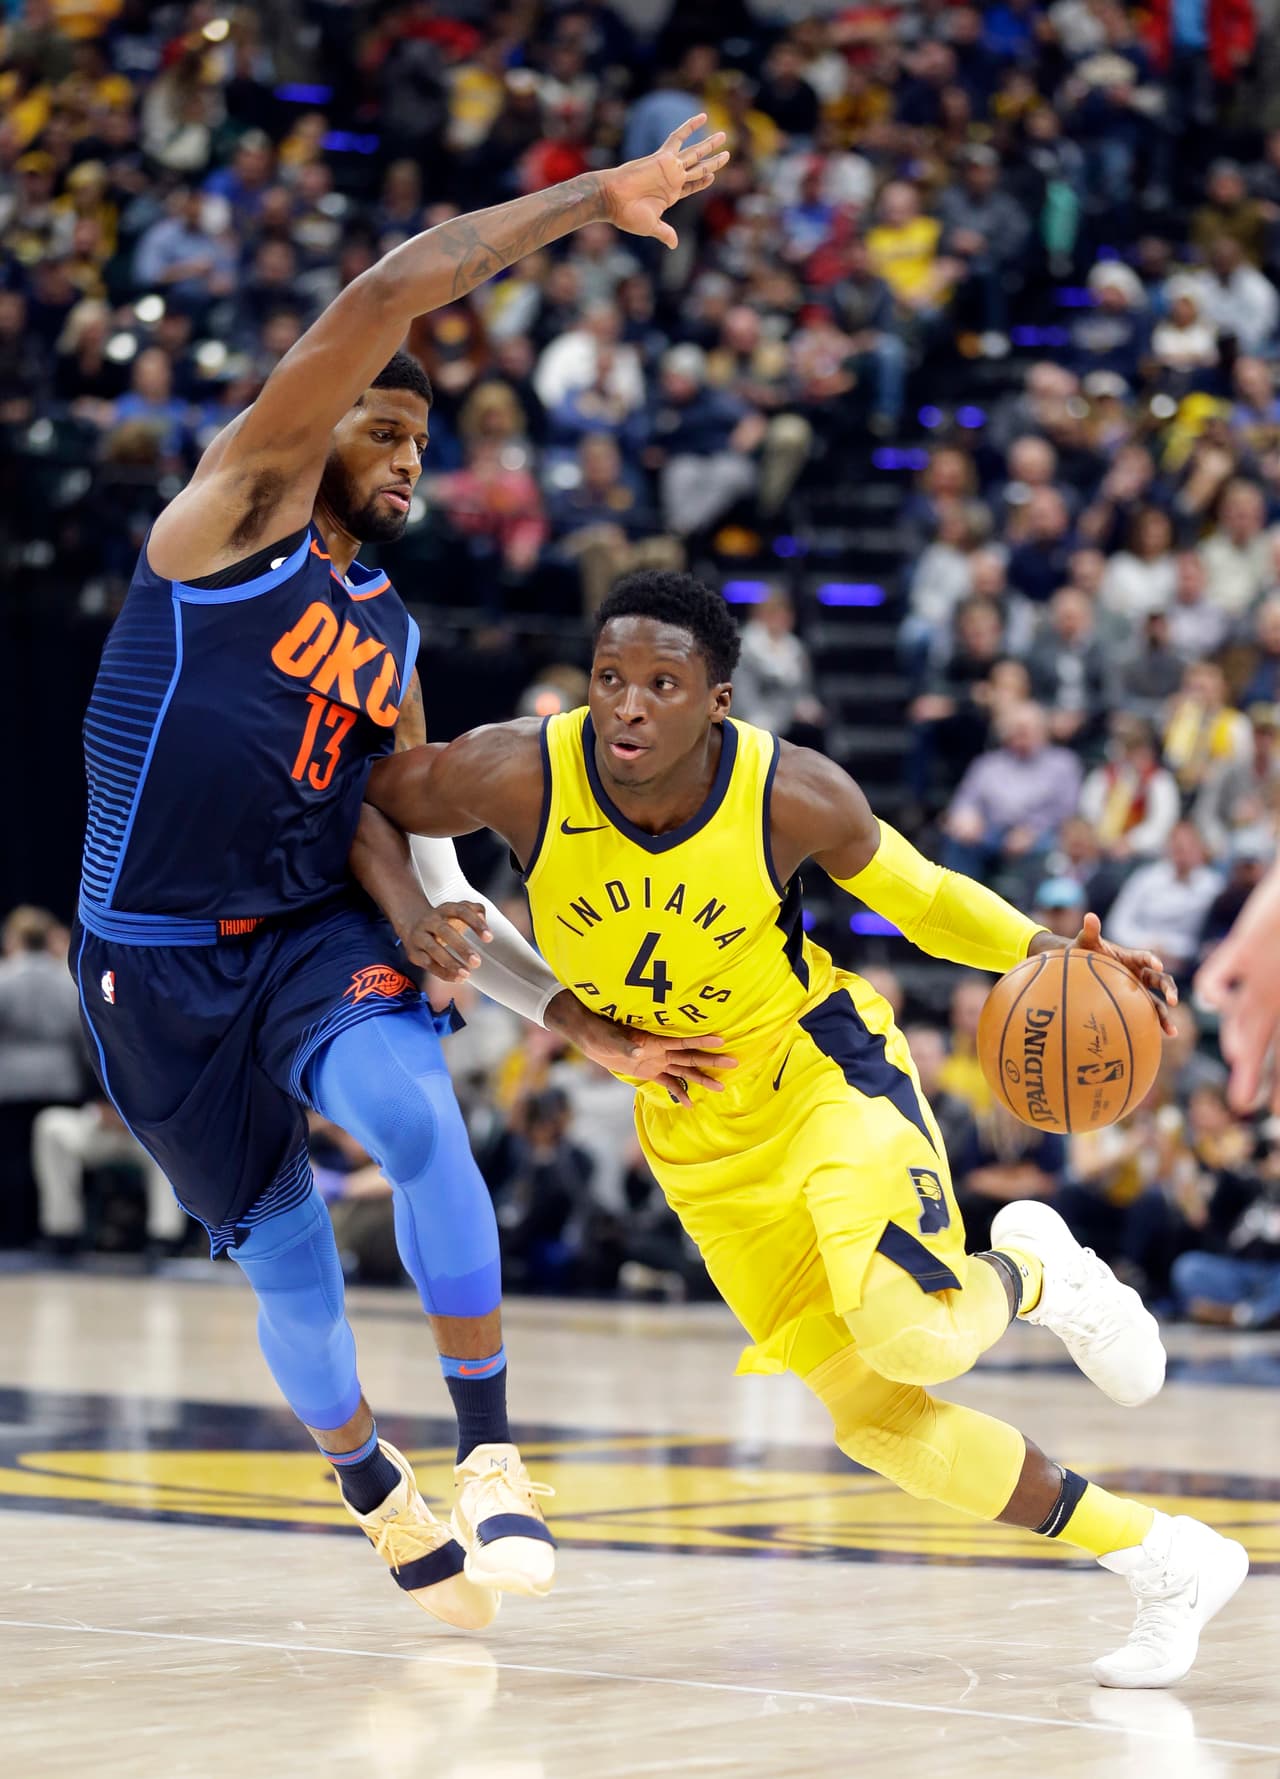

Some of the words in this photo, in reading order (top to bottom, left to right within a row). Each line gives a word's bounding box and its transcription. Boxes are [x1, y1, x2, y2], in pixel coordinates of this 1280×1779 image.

[271, 601, 400, 727] OKC
[291, 692, 358, 790] 13
[556, 877, 746, 950] INDIANA
[624, 932, 672, 1004] 4
[1024, 1007, 1060, 1124] SPALDING
